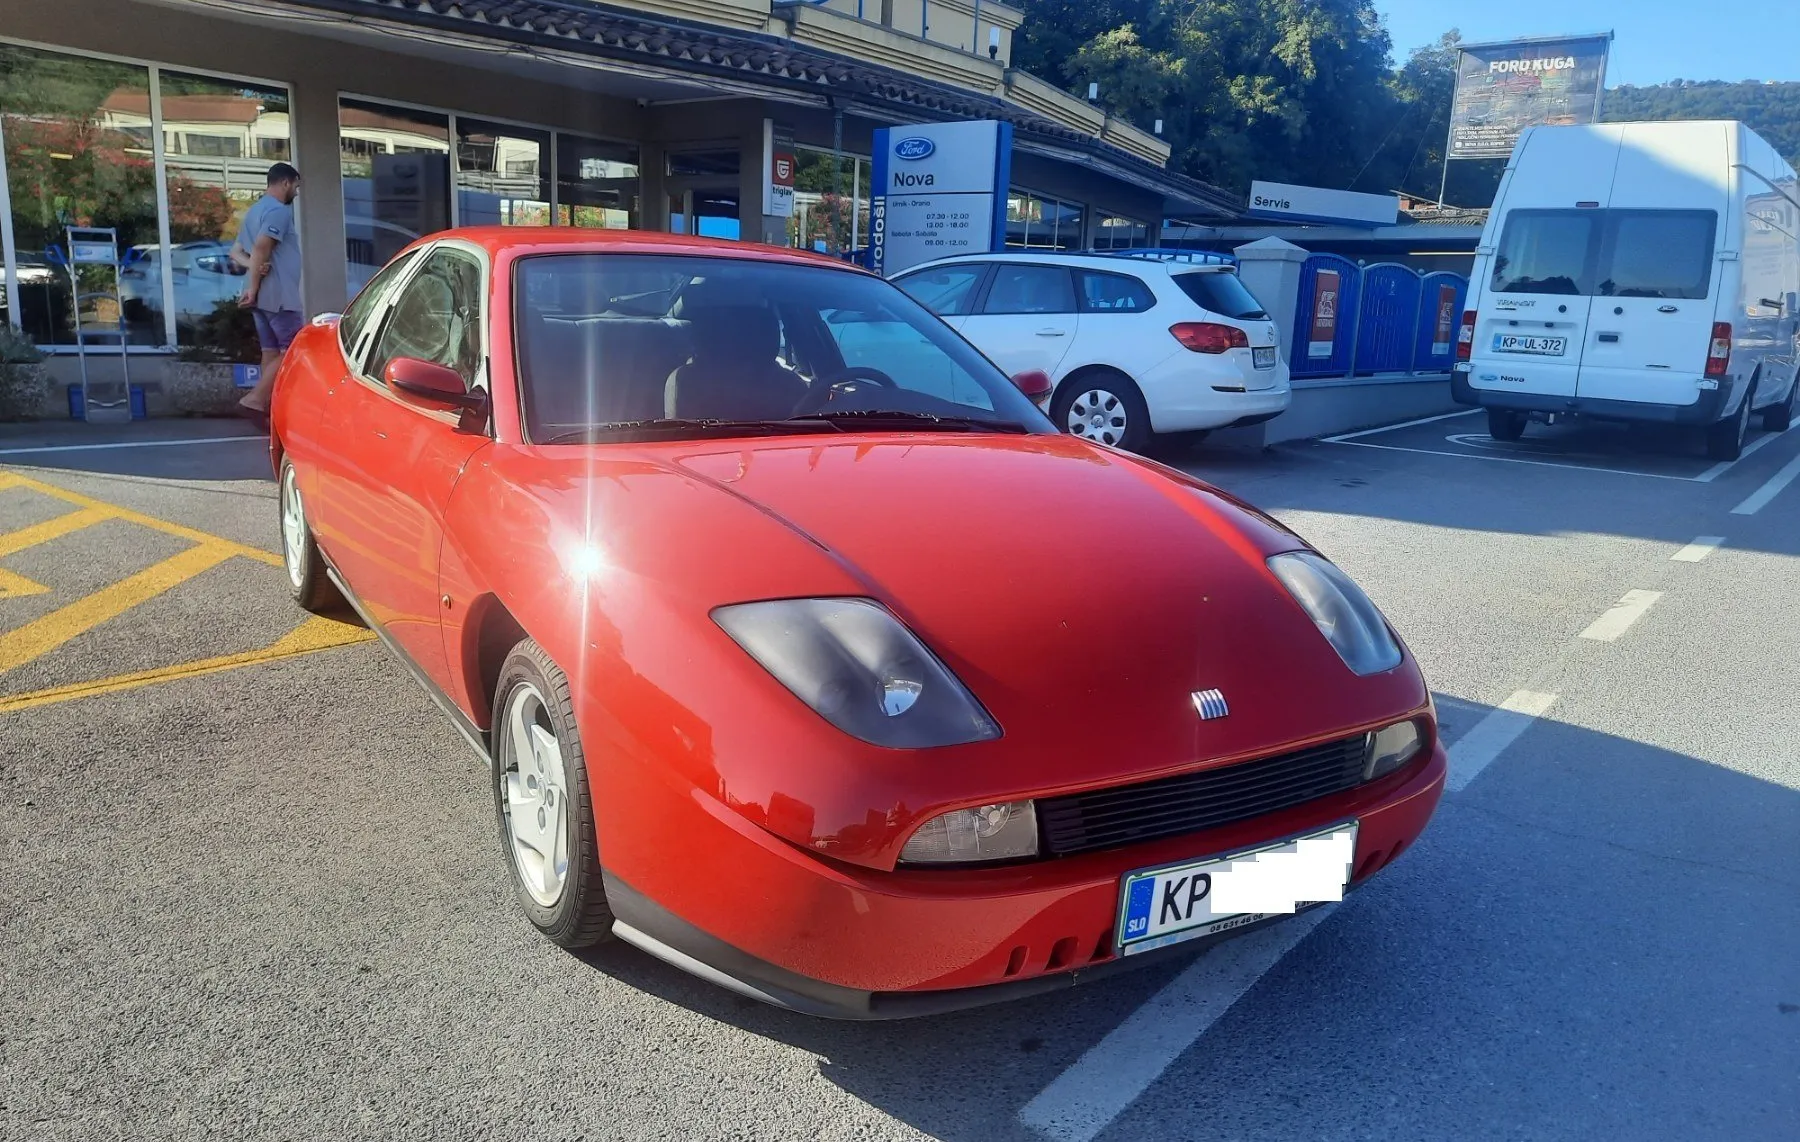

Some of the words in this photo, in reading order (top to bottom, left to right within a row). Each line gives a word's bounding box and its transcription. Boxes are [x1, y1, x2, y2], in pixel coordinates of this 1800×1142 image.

[1489, 59, 1531, 74] FORD
[1532, 56, 1576, 74] KUGA
[893, 172, 934, 187] Nova
[772, 186, 793, 198] triglav
[1254, 196, 1291, 209] Servis
[1502, 336, 1517, 348] KP
[1524, 338, 1562, 351] UL-372
[1500, 375, 1525, 383] Nova
[1159, 872, 1212, 926] KP
[1127, 916, 1147, 934] SLO
